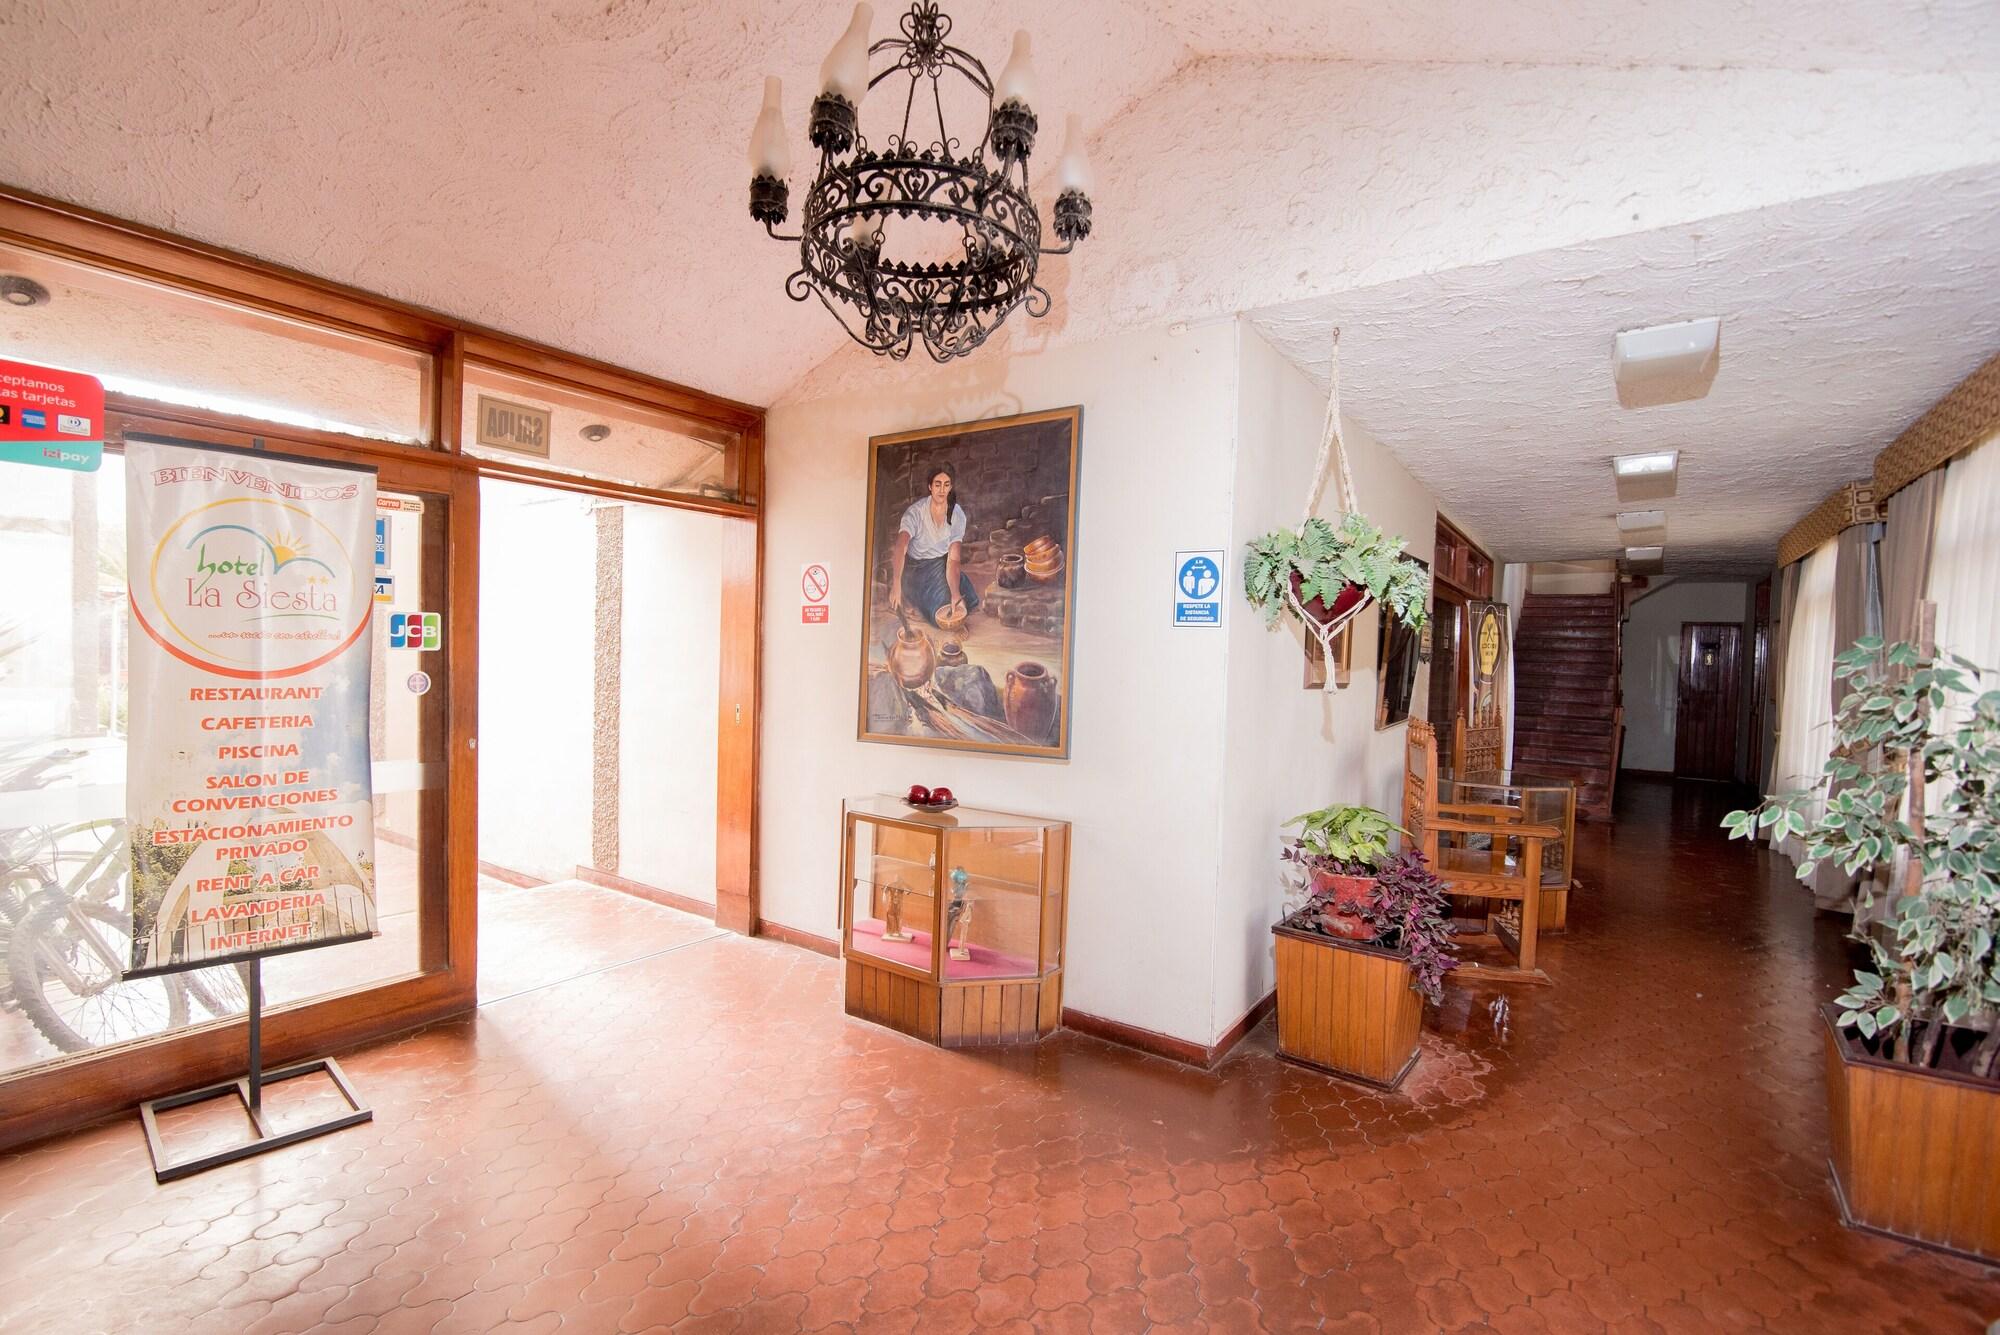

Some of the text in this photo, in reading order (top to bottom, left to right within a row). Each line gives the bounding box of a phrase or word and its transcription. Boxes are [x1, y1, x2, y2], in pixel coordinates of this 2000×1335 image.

[22, 390, 76, 408] tarjetas
[152, 466, 359, 500] BIENVENIDOS
[194, 543, 265, 594] hotel
[185, 577, 338, 612] La Siesta
[190, 687, 324, 701] RESTAURANT
[201, 715, 314, 731] CAFETERIA
[218, 743, 299, 760] PISCINA
[206, 771, 310, 790] SALON DE
[172, 788, 338, 813] CONVENCIONES
[153, 814, 354, 845] ESTACIONAMIENTO
[216, 839, 308, 861] PRIVADO
[196, 865, 319, 893] RENT A CAR
[191, 892, 326, 924] LAVANDERIA
[209, 922, 312, 951] INTERNET
